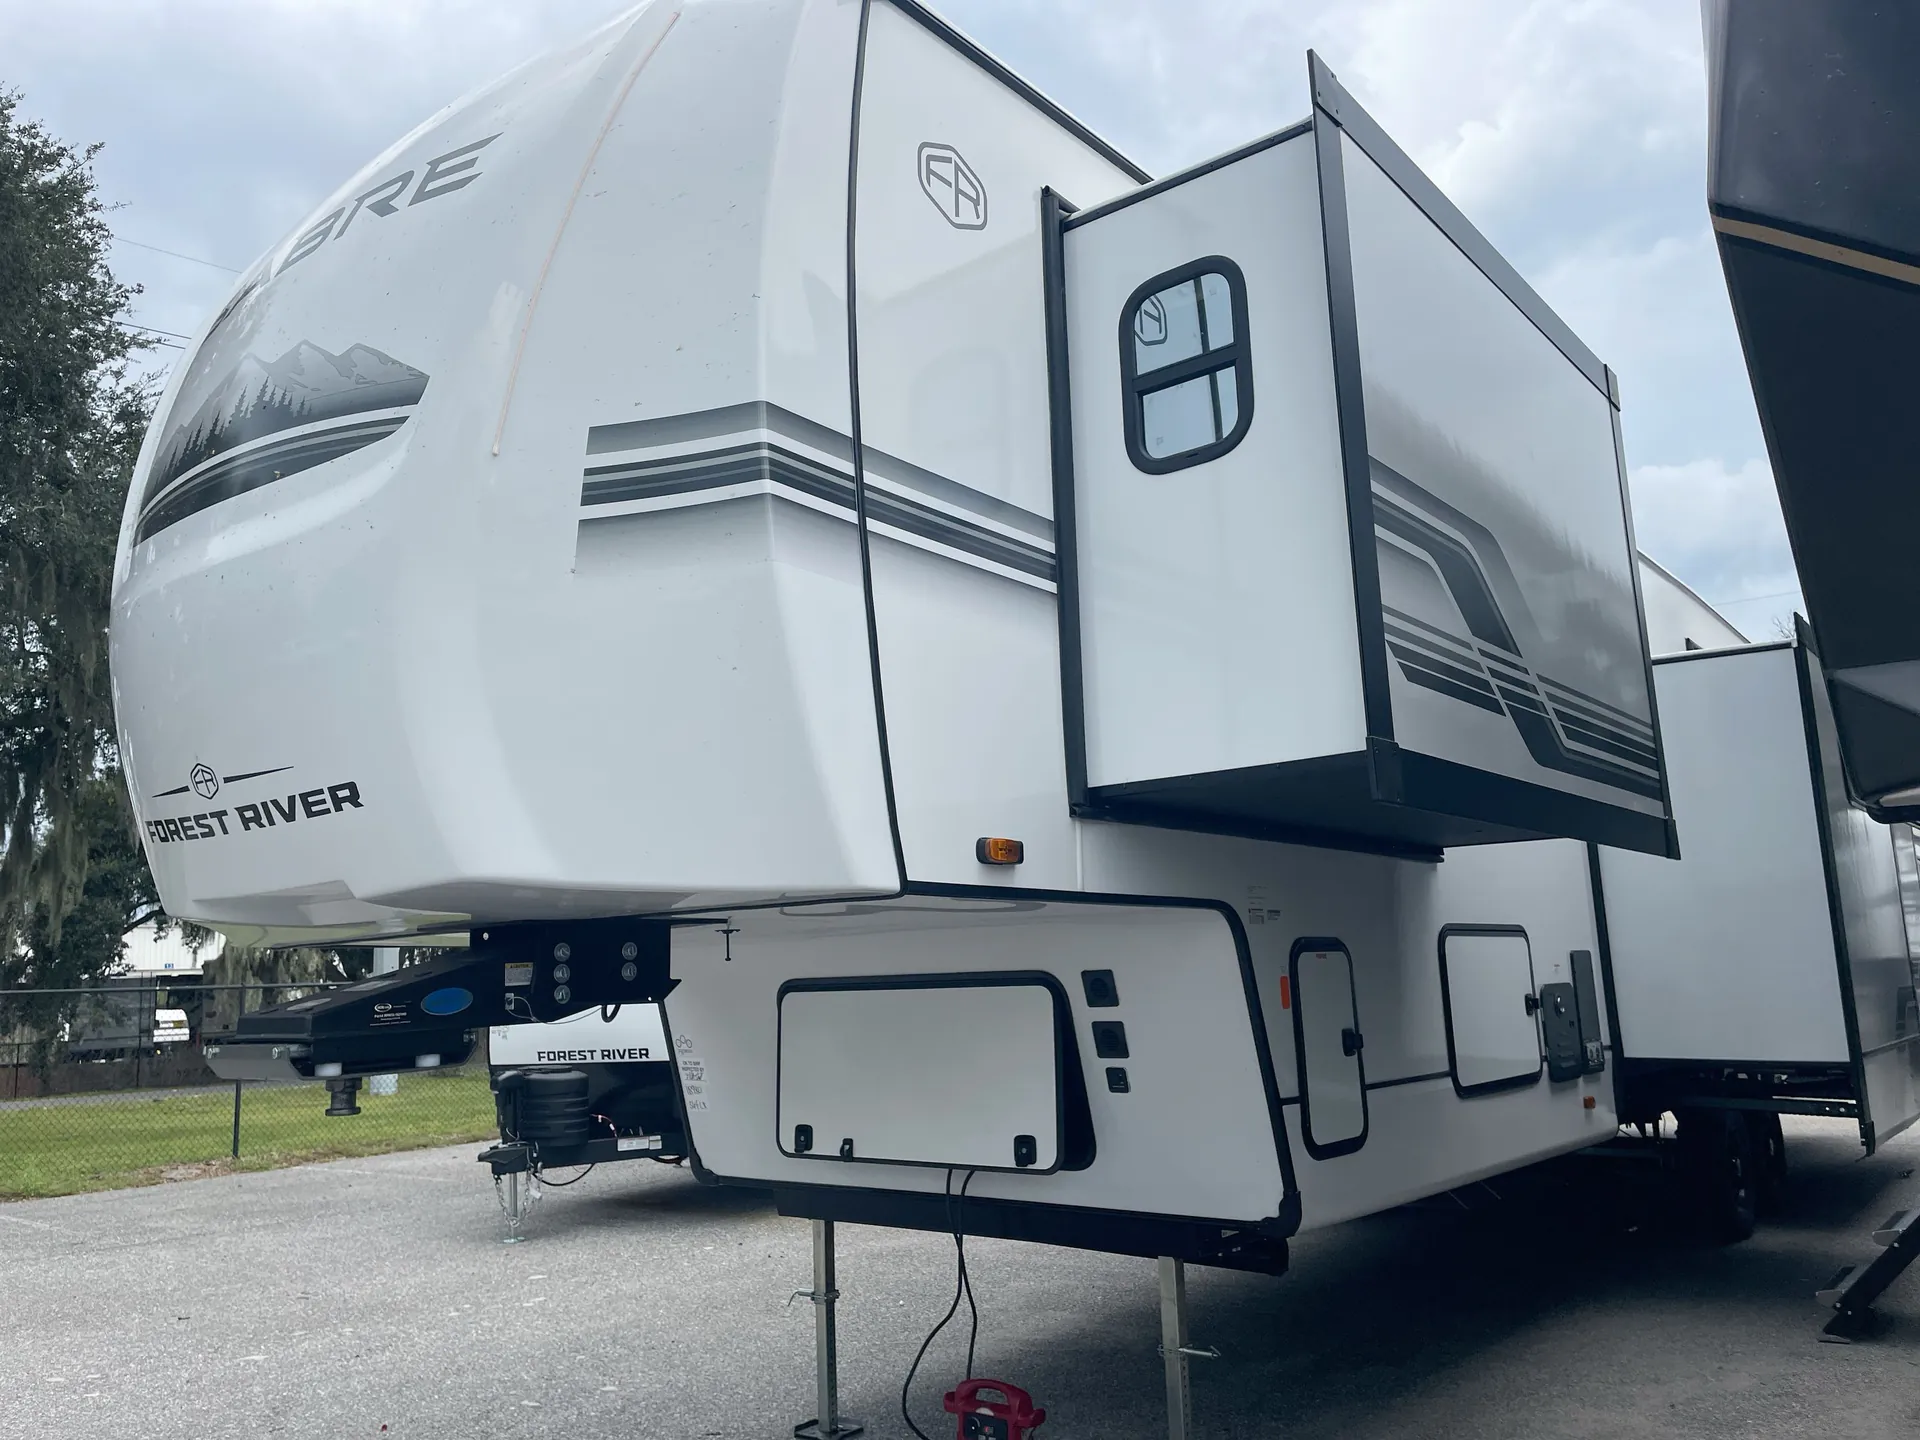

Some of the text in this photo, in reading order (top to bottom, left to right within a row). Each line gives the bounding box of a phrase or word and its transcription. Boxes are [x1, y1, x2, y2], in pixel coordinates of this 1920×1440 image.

[145, 781, 365, 844] FOREST RIVER
[537, 1047, 650, 1062] FOREST RIVER
